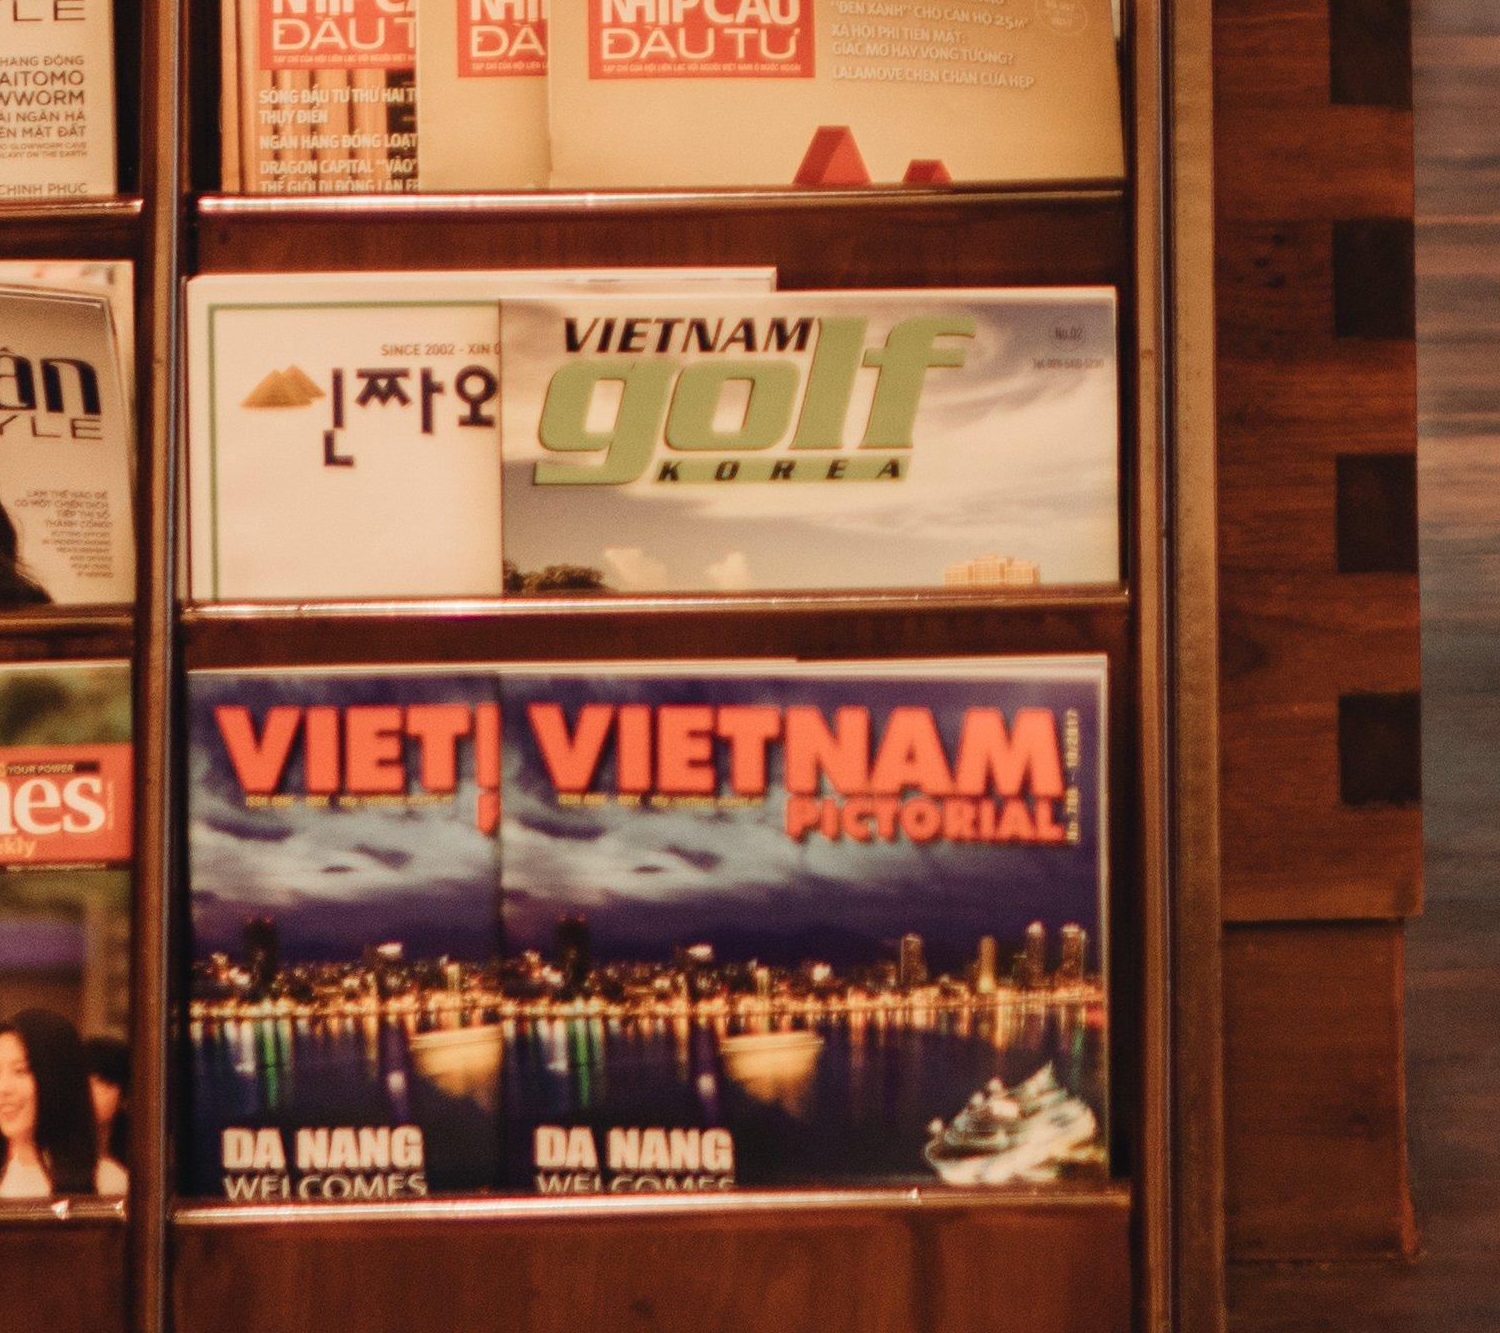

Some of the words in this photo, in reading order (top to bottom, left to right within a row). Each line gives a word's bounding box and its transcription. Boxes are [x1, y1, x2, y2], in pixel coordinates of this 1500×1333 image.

[601, 26, 714, 61] ĐẦU
[722, 26, 801, 61] TƯ
[0, 56, 38, 67] HANG
[832, 65, 904, 81] LALAMOVE
[905, 68, 939, 83] CHEN
[260, 160, 317, 174] DRAGON
[320, 159, 372, 174] CAPITAL
[380, 343, 421, 357] SINCE
[424, 343, 455, 356] 2002
[468, 343, 491, 355] XIN
[564, 316, 816, 353] VIETNAM
[532, 315, 978, 486] golf
[657, 458, 902, 483] KOREA
[525, 701, 1066, 798] VIETNAM
[9, 765, 36, 775] YOUR
[784, 794, 1066, 845] PICTORIAL
[220, 1126, 286, 1170] DA
[296, 1126, 425, 1170] NANG
[534, 1126, 597, 1170] DA
[607, 1127, 734, 1172] NANG
